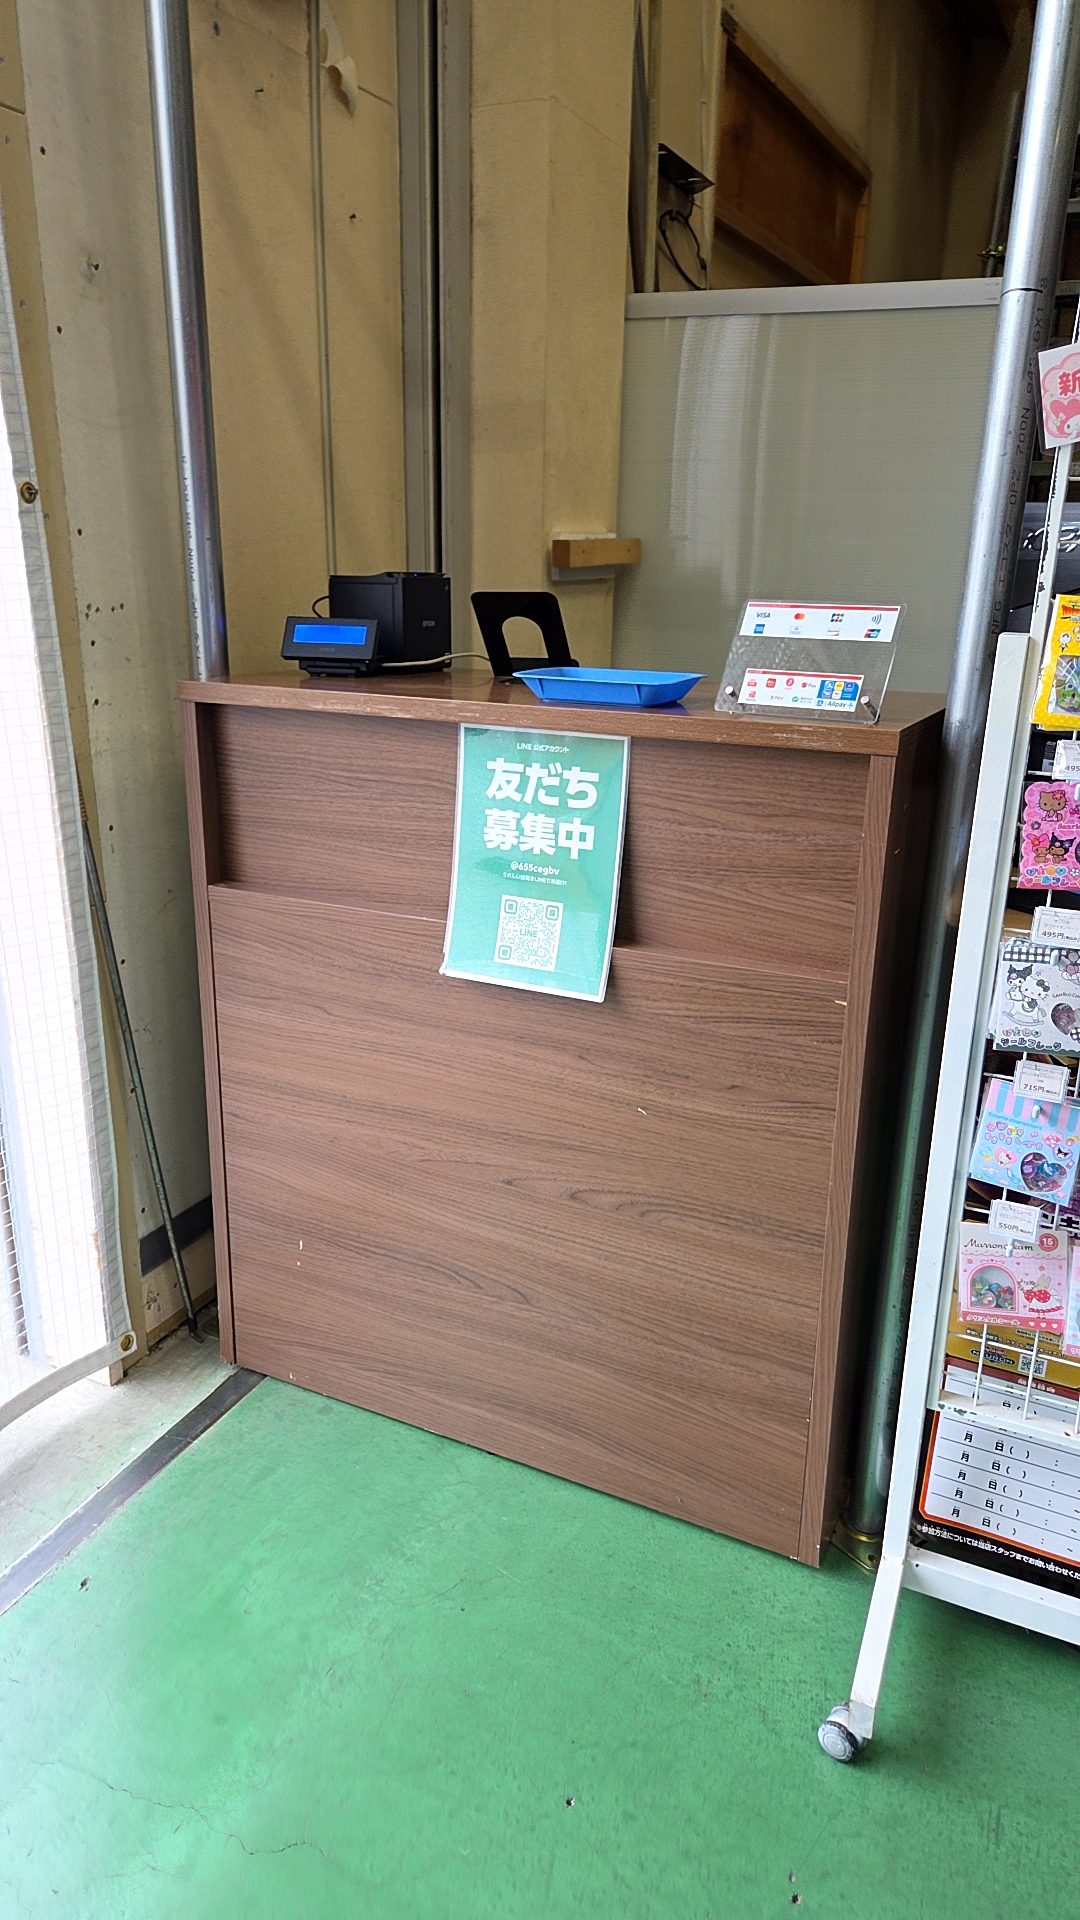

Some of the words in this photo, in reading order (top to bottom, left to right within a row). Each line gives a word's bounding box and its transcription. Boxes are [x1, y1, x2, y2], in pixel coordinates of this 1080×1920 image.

[991, 600, 1002, 635] NFG
[1015, 406, 1030, 456] 700N
[485, 757, 600, 809] 友だち
[483, 807, 595, 860] 募集中
[510, 861, 560, 875] @655cegbv
[519, 927, 538, 938] LINE
[1042, 1237, 1054, 1246] 15
[971, 1350, 1014, 1365] NURON
[963, 1432, 973, 1443] 月
[960, 1452, 970, 1463] 月
[957, 1470, 967, 1480] 月
[954, 1488, 964, 1499] 月
[951, 1507, 960, 1518] 月
